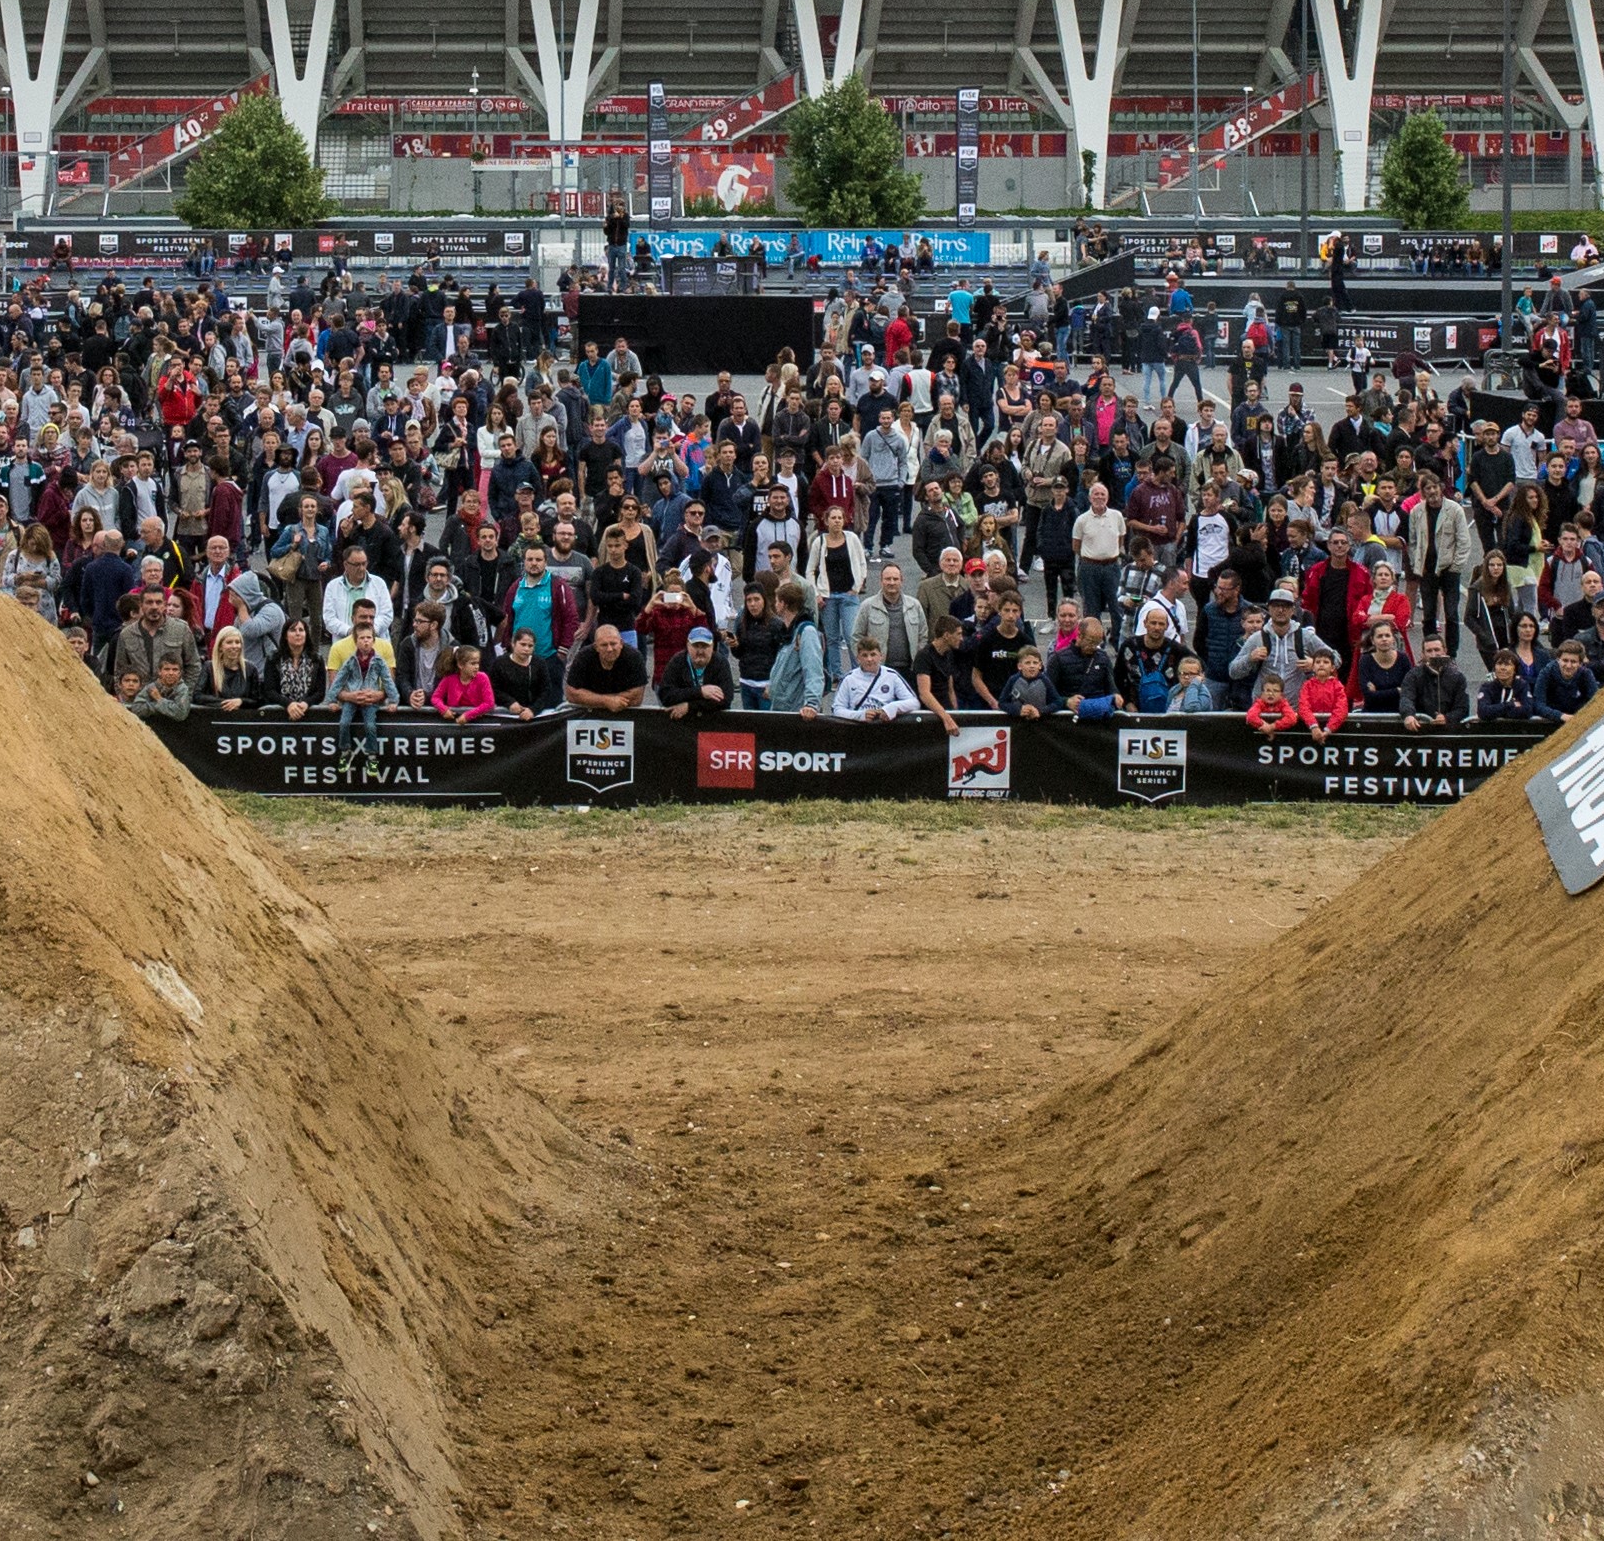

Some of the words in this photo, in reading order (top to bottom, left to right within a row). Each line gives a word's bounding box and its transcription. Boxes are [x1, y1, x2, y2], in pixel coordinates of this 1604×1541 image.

[172, 237, 206, 245] XTREME
[376, 236, 394, 244] FISE
[448, 236, 487, 244] XTREMES
[506, 236, 523, 244] FISE
[648, 233, 704, 254] Reims
[729, 233, 787, 254] Rems
[575, 726, 626, 750] FISE
[216, 735, 337, 756] SPORTS
[353, 736, 496, 756] XTREMES
[1126, 736, 1179, 759] FISE
[576, 759, 626, 768] XPERIENCE
[709, 749, 753, 771] SFR
[759, 751, 847, 773] SPORT
[1258, 745, 1379, 767] SPORTS
[1394, 747, 1532, 769] XTREME
[283, 765, 430, 784] FESTIVAL
[585, 767, 616, 776] SERIES
[1126, 769, 1178, 778] XPERIENCE
[1136, 777, 1168, 785] SERIES
[1324, 775, 1472, 798] FESTIVAL
[962, 789, 985, 798] MUSIC
[986, 789, 1007, 798] ONLY
